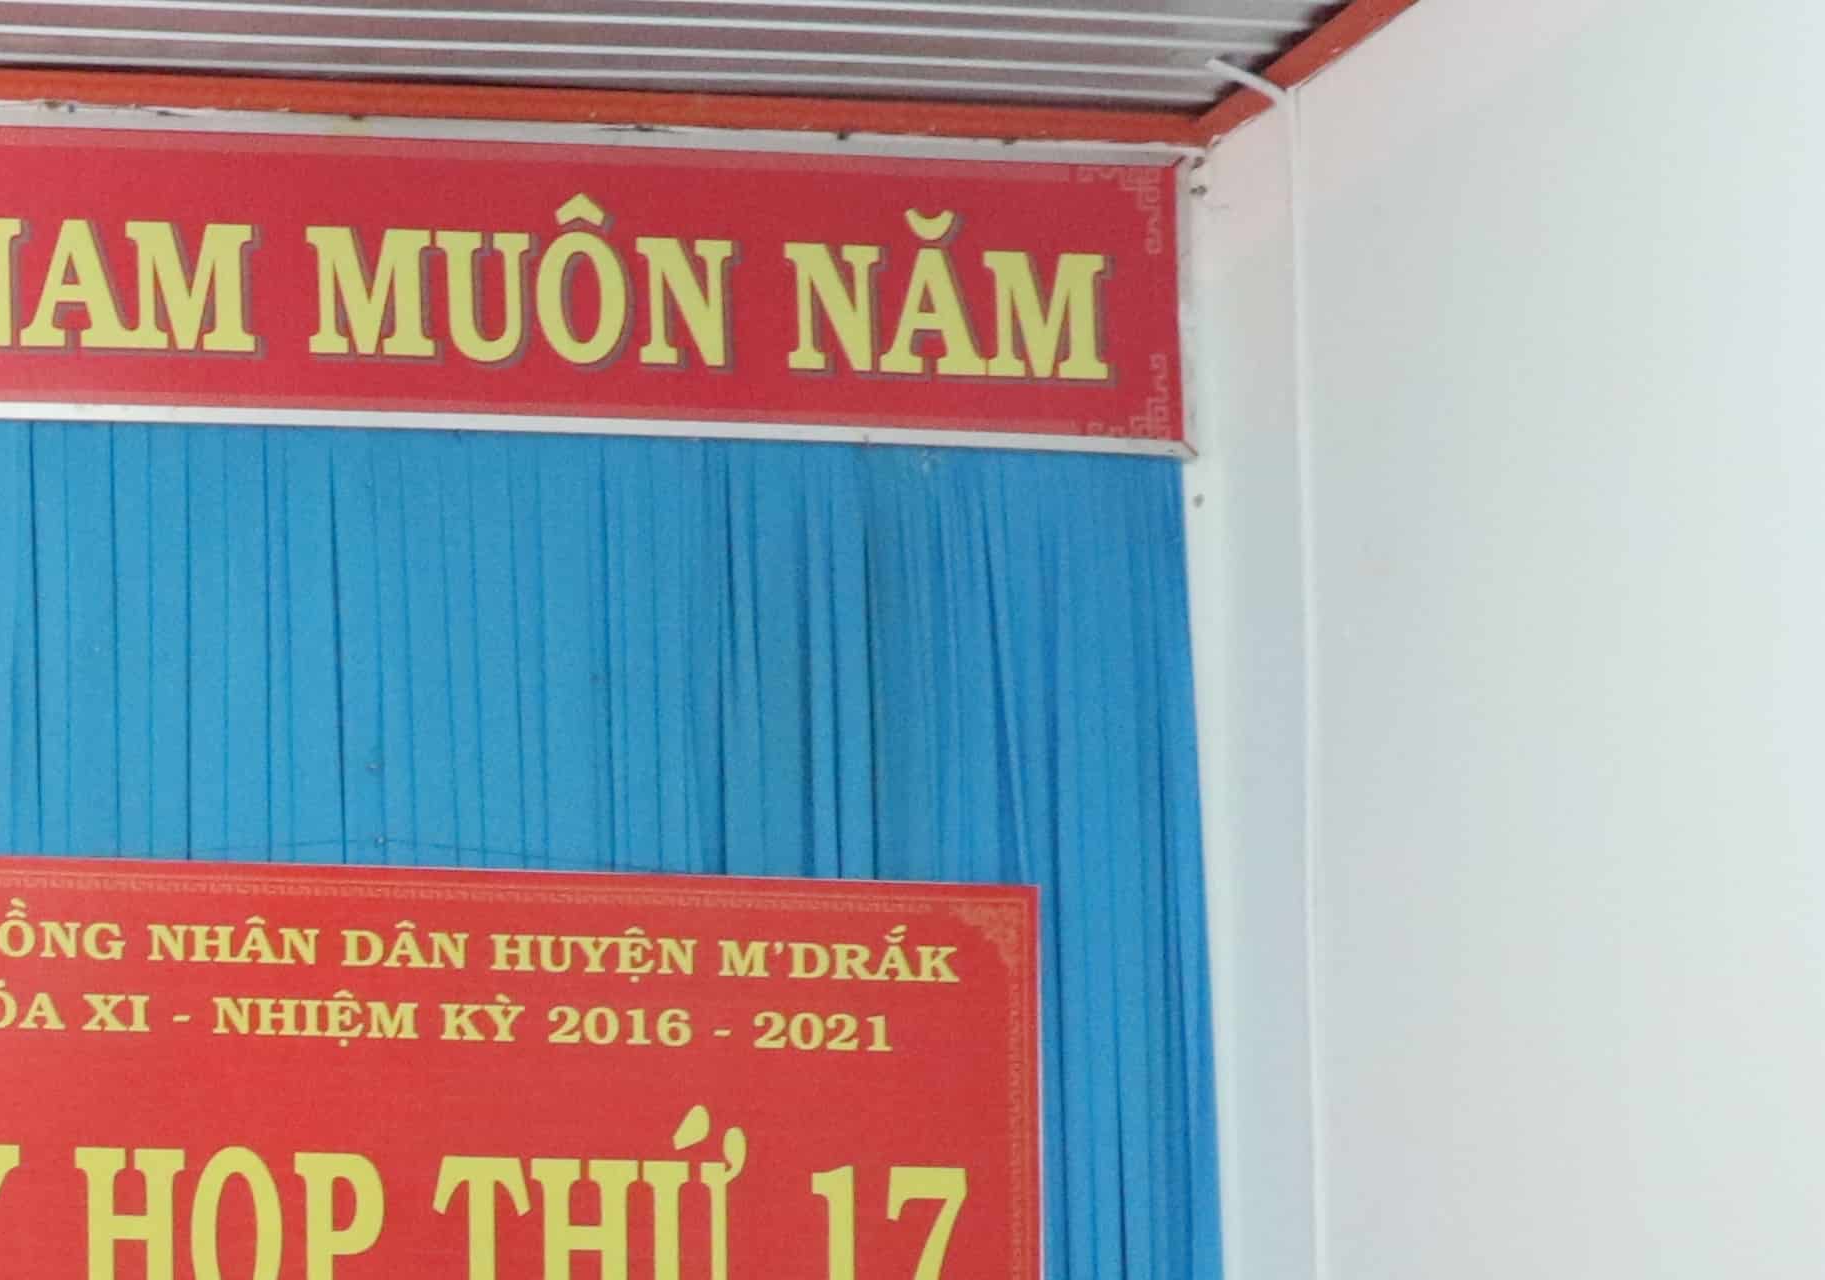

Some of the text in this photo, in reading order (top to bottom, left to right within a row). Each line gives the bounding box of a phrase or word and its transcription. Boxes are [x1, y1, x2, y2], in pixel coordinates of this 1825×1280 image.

[305, 192, 733, 367] MUÔN
[784, 208, 1109, 380] NĂM
[146, 915, 321, 966] NHÂN
[340, 919, 471, 970] DÂN
[489, 926, 698, 983] HUYỆN
[81, 992, 151, 1033] XI
[171, 1014, 191, 1024] -
[211, 989, 419, 1048] NHIỆM
[439, 993, 527, 1043] KỲ
[547, 1005, 693, 1048] 2016
[713, 1028, 732, 1038] -
[753, 1010, 892, 1052] 2021
